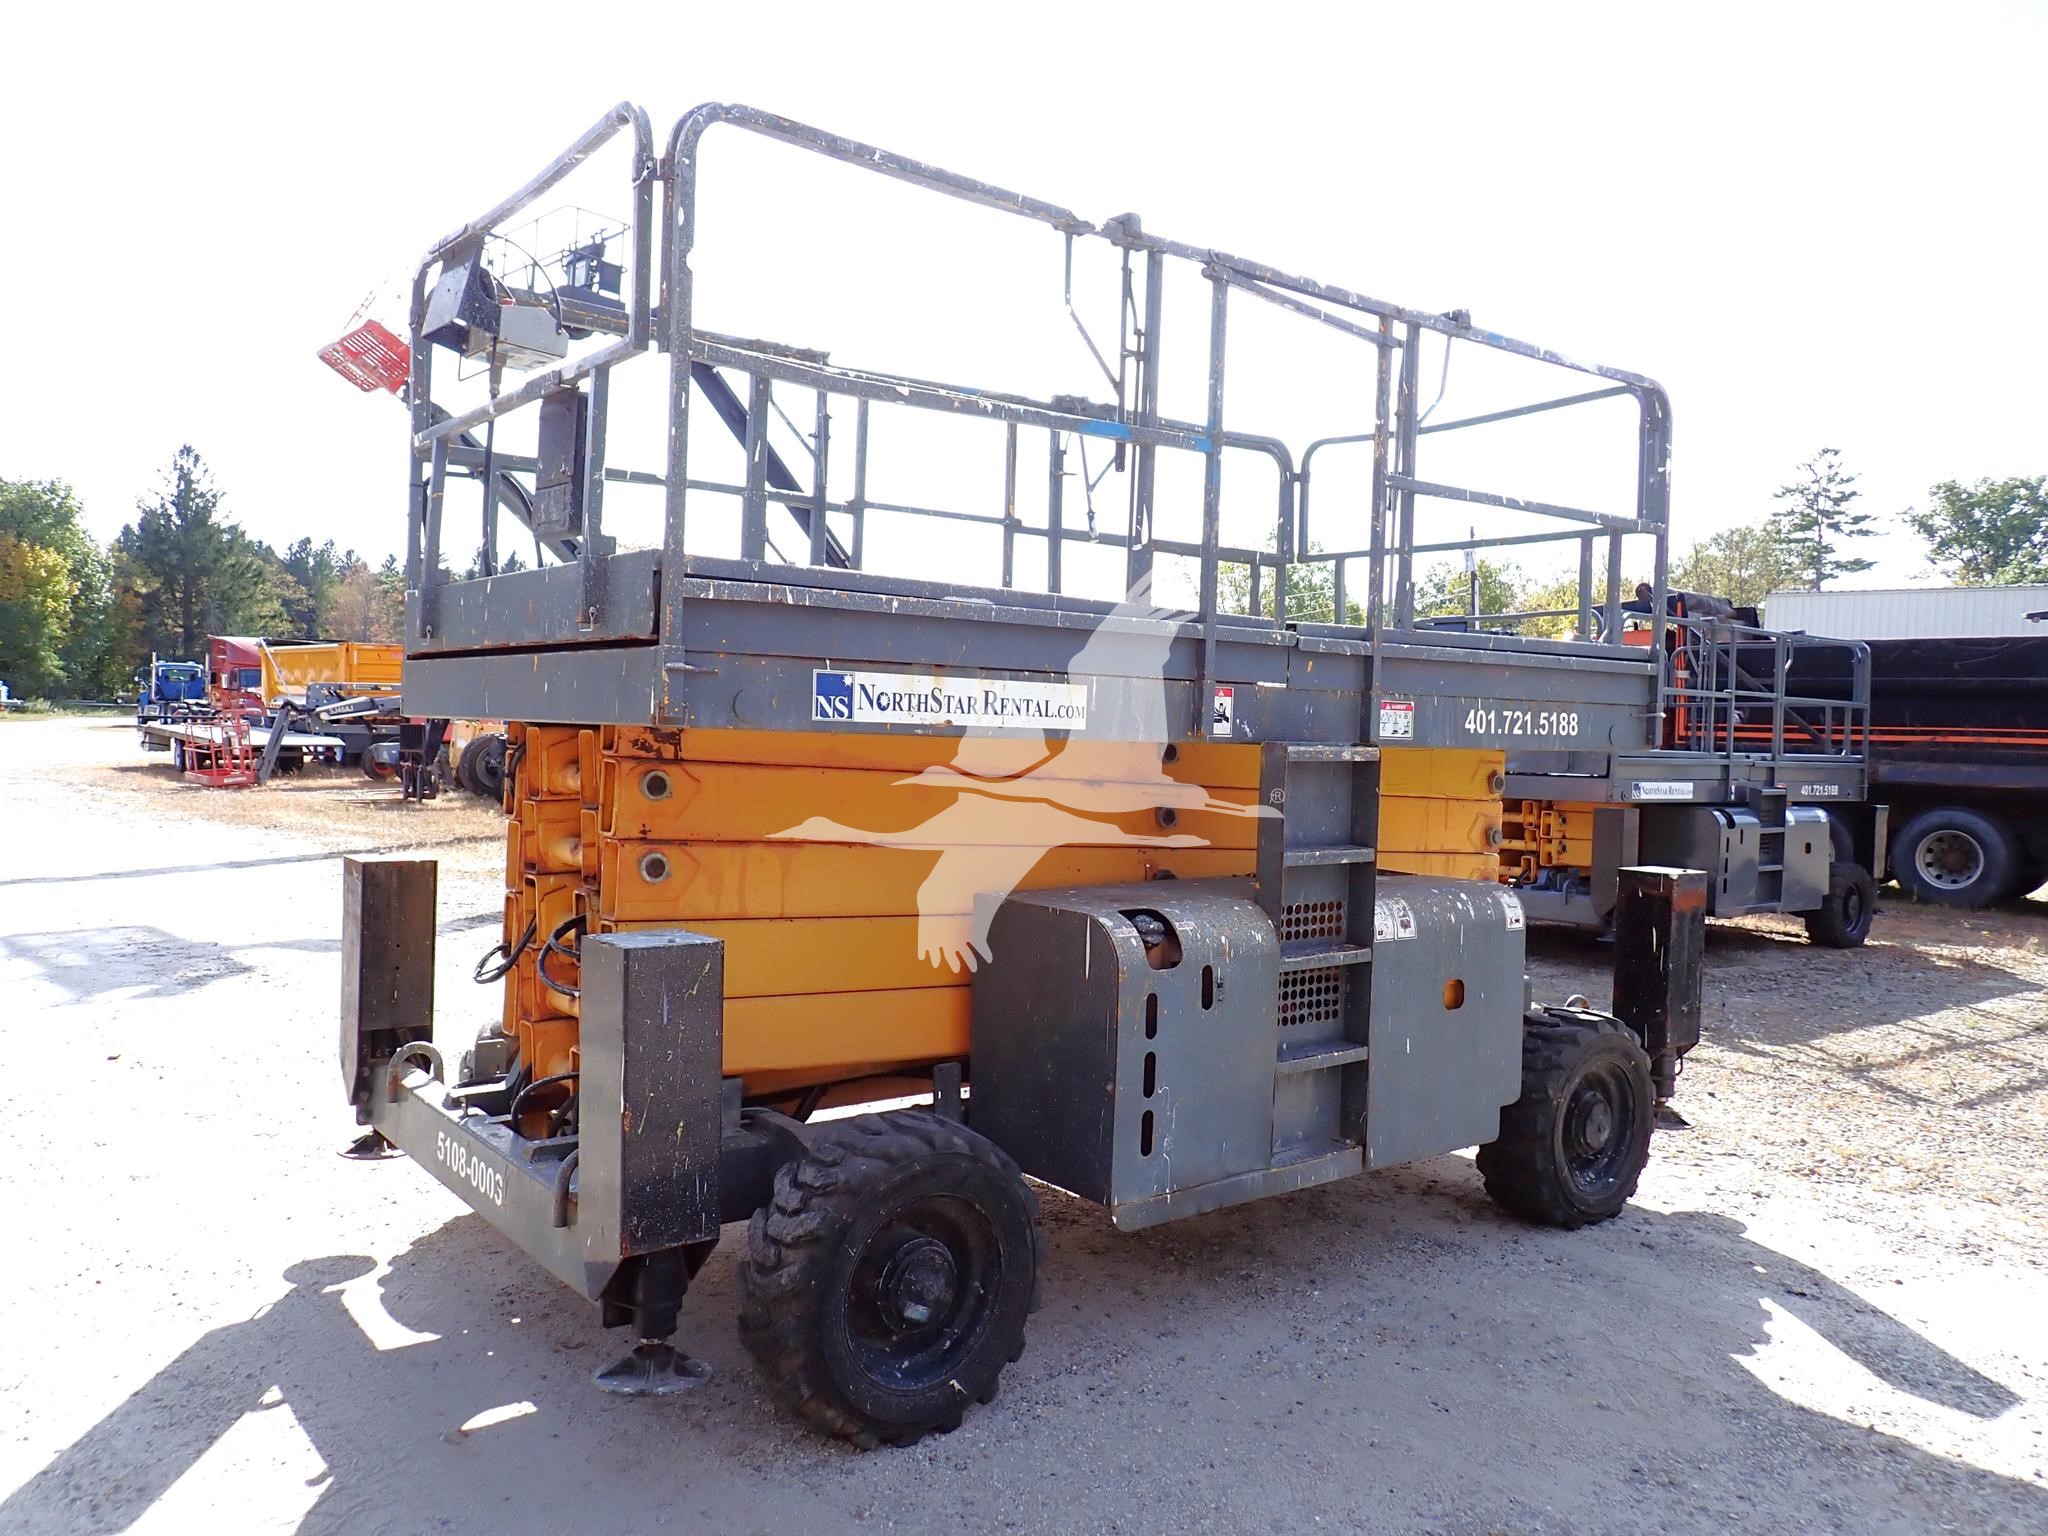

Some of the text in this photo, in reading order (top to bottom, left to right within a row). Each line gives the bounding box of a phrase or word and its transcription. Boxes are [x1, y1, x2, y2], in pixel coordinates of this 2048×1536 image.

[815, 695, 849, 719] NS
[1464, 709, 1579, 736] 401.721.5188
[437, 1130, 503, 1206] 5108-0003
